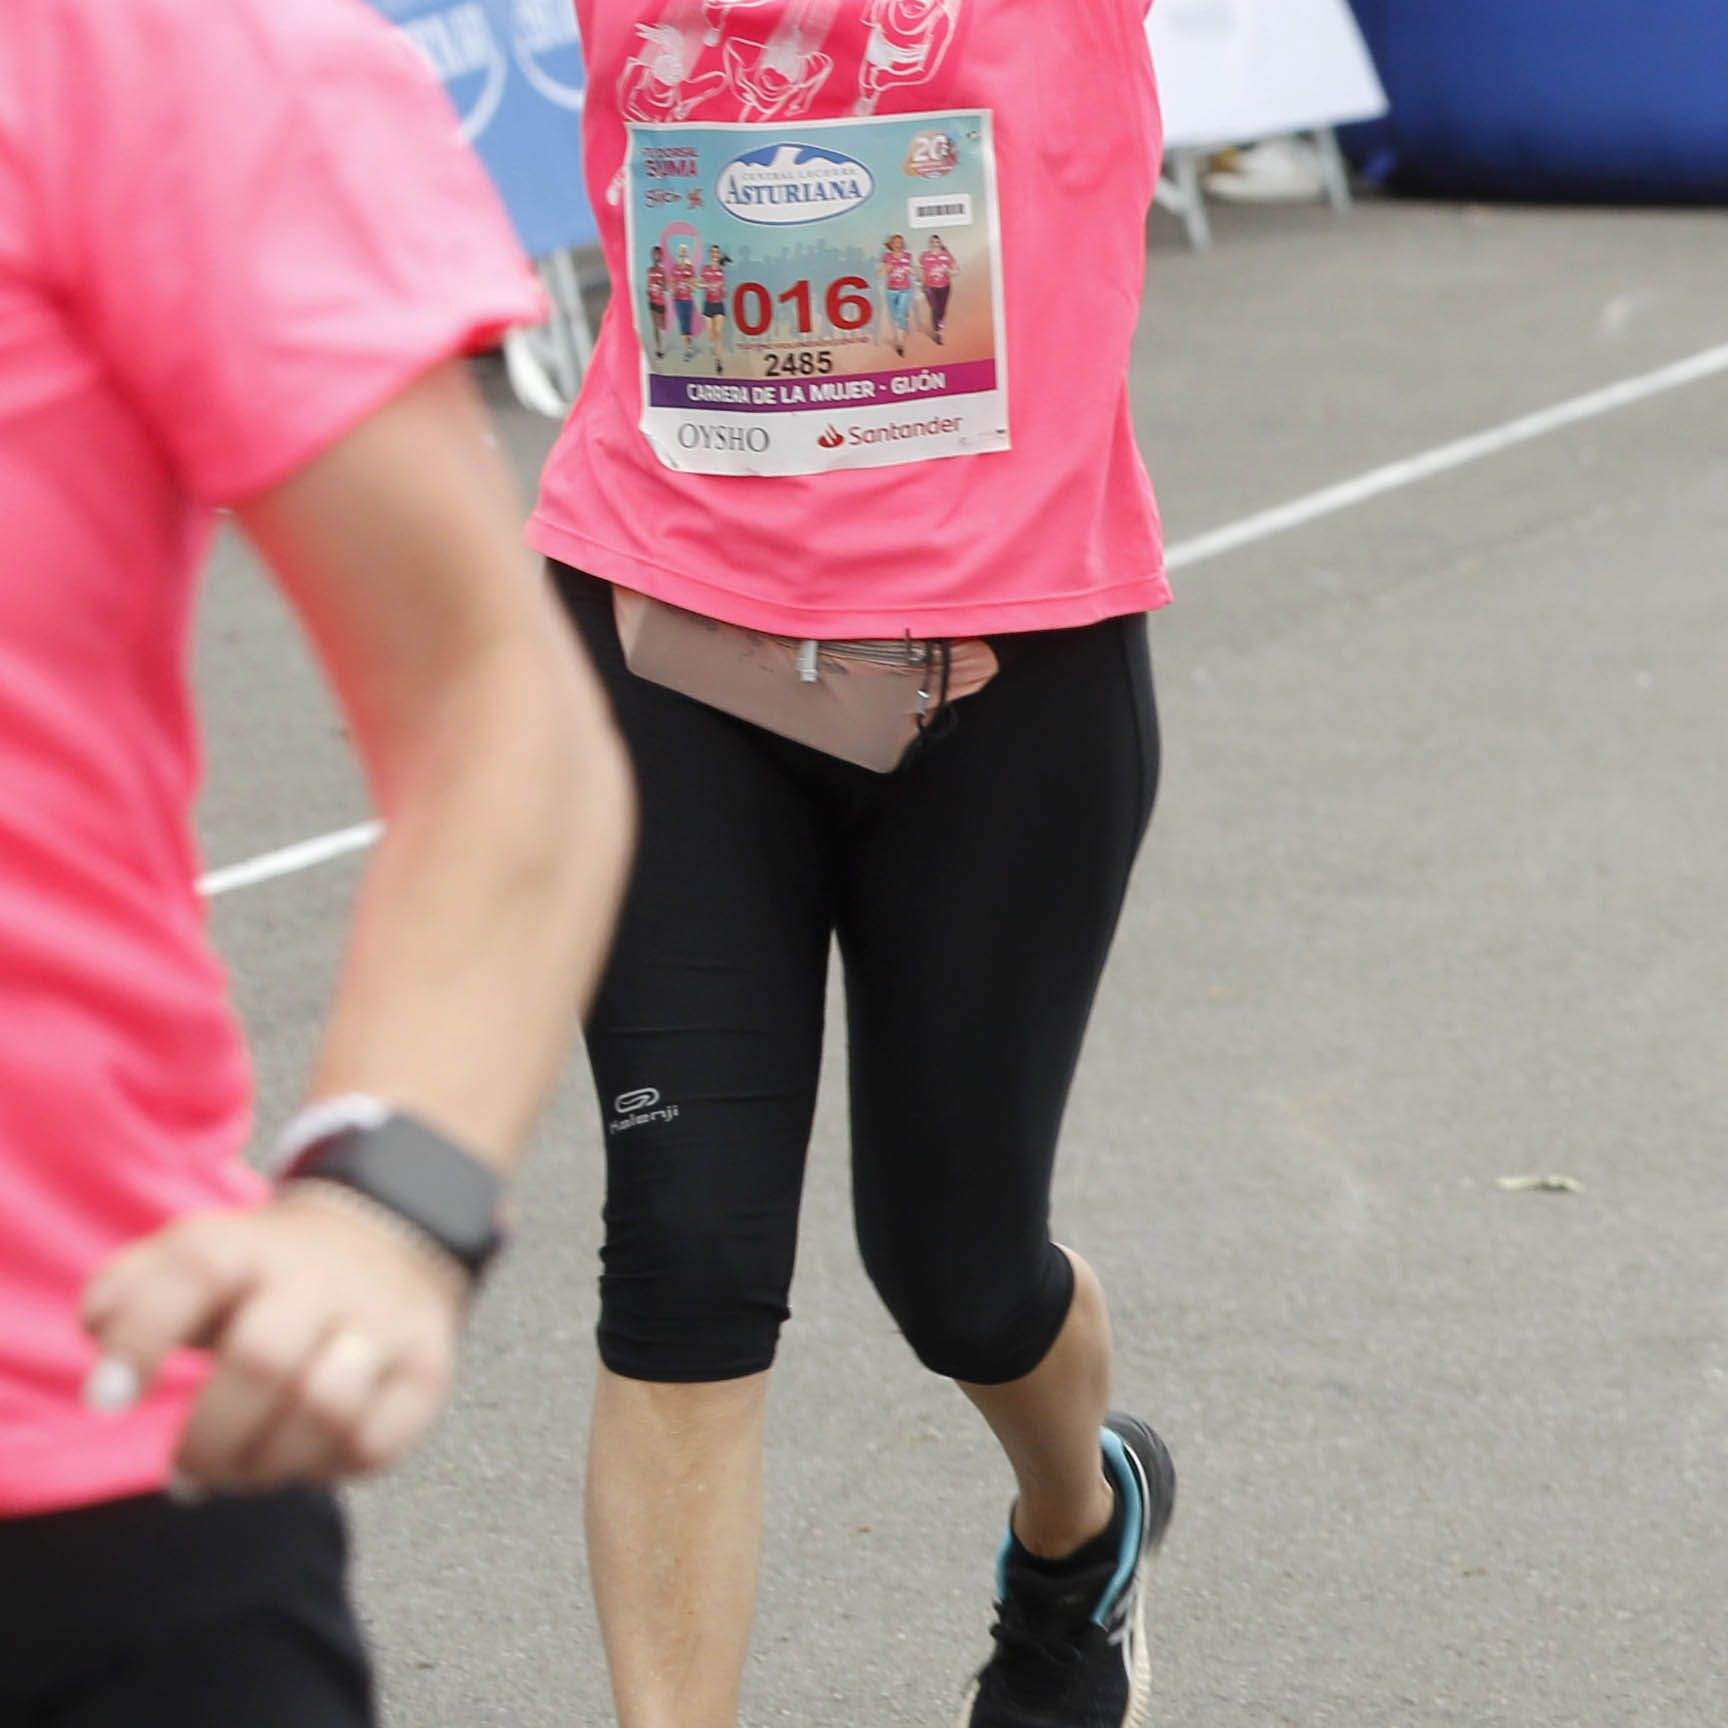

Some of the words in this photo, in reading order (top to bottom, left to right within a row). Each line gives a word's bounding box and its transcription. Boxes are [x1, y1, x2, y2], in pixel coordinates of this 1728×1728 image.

[645, 159, 698, 178] SUMA
[726, 175, 863, 205] ASTURIANA
[732, 276, 874, 336] 016
[764, 350, 833, 377] 2485
[686, 383, 749, 404] CARRERA
[751, 385, 777, 405] DE
[780, 383, 805, 404] LA
[809, 380, 876, 402] MUJER
[677, 422, 771, 453] OYSHO
[848, 416, 964, 447] Santander
